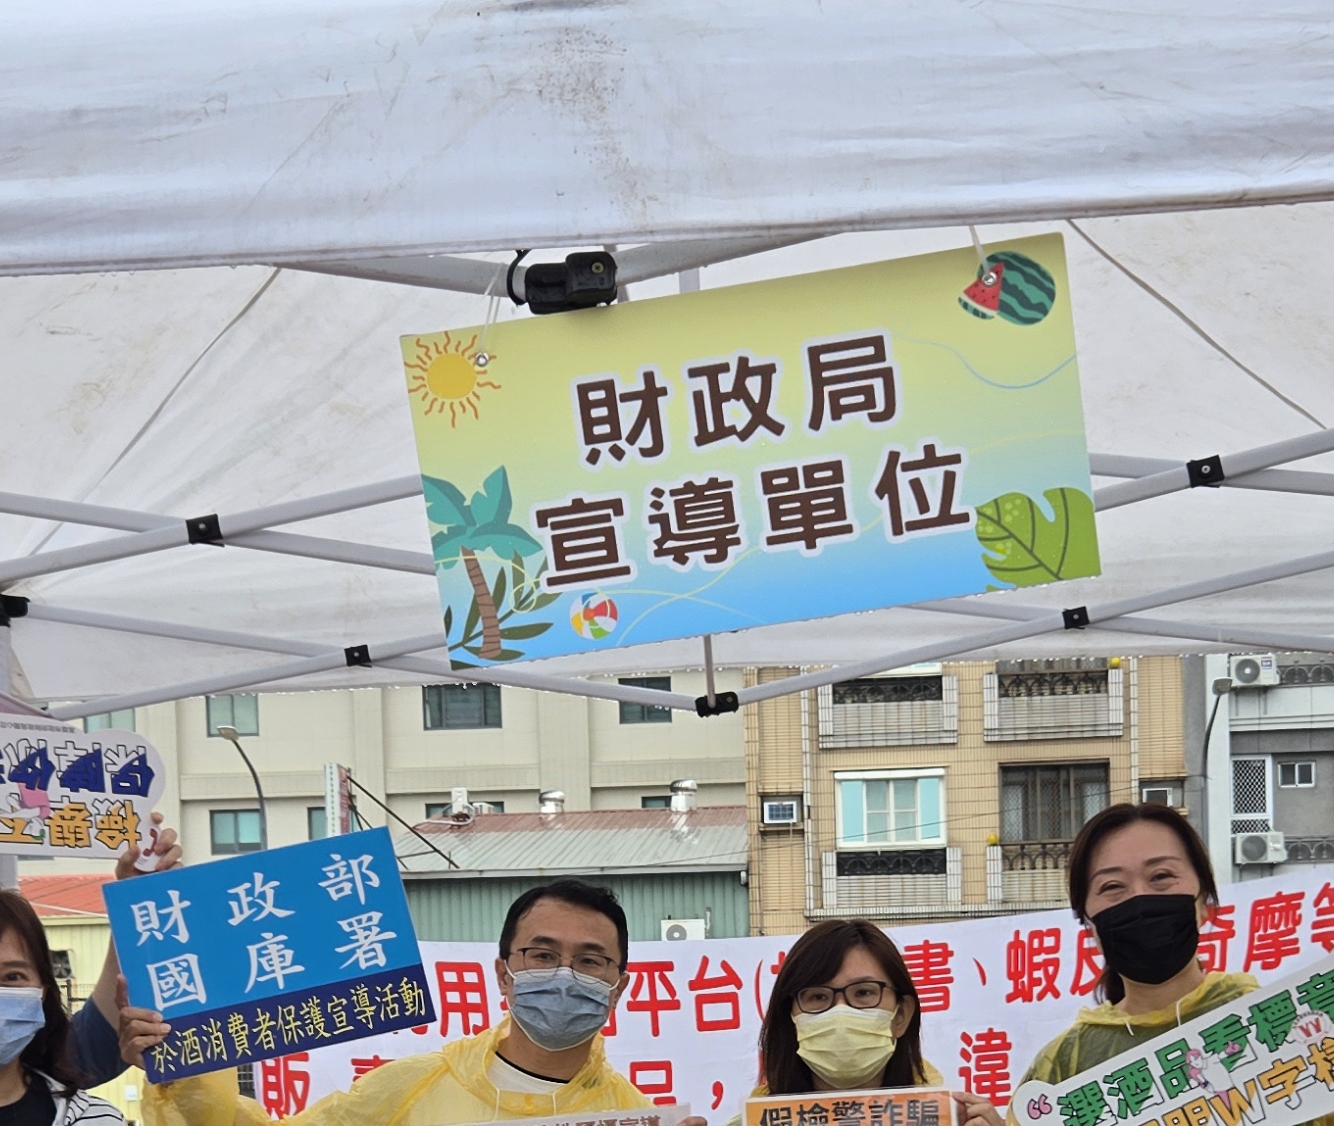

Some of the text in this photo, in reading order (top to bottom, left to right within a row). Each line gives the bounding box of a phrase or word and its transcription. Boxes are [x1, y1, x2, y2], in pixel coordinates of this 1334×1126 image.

[576, 334, 898, 466] 財政局
[535, 443, 970, 586] 宣導單位
[130, 853, 381, 948] 財政部
[146, 910, 397, 1012] 國庫署
